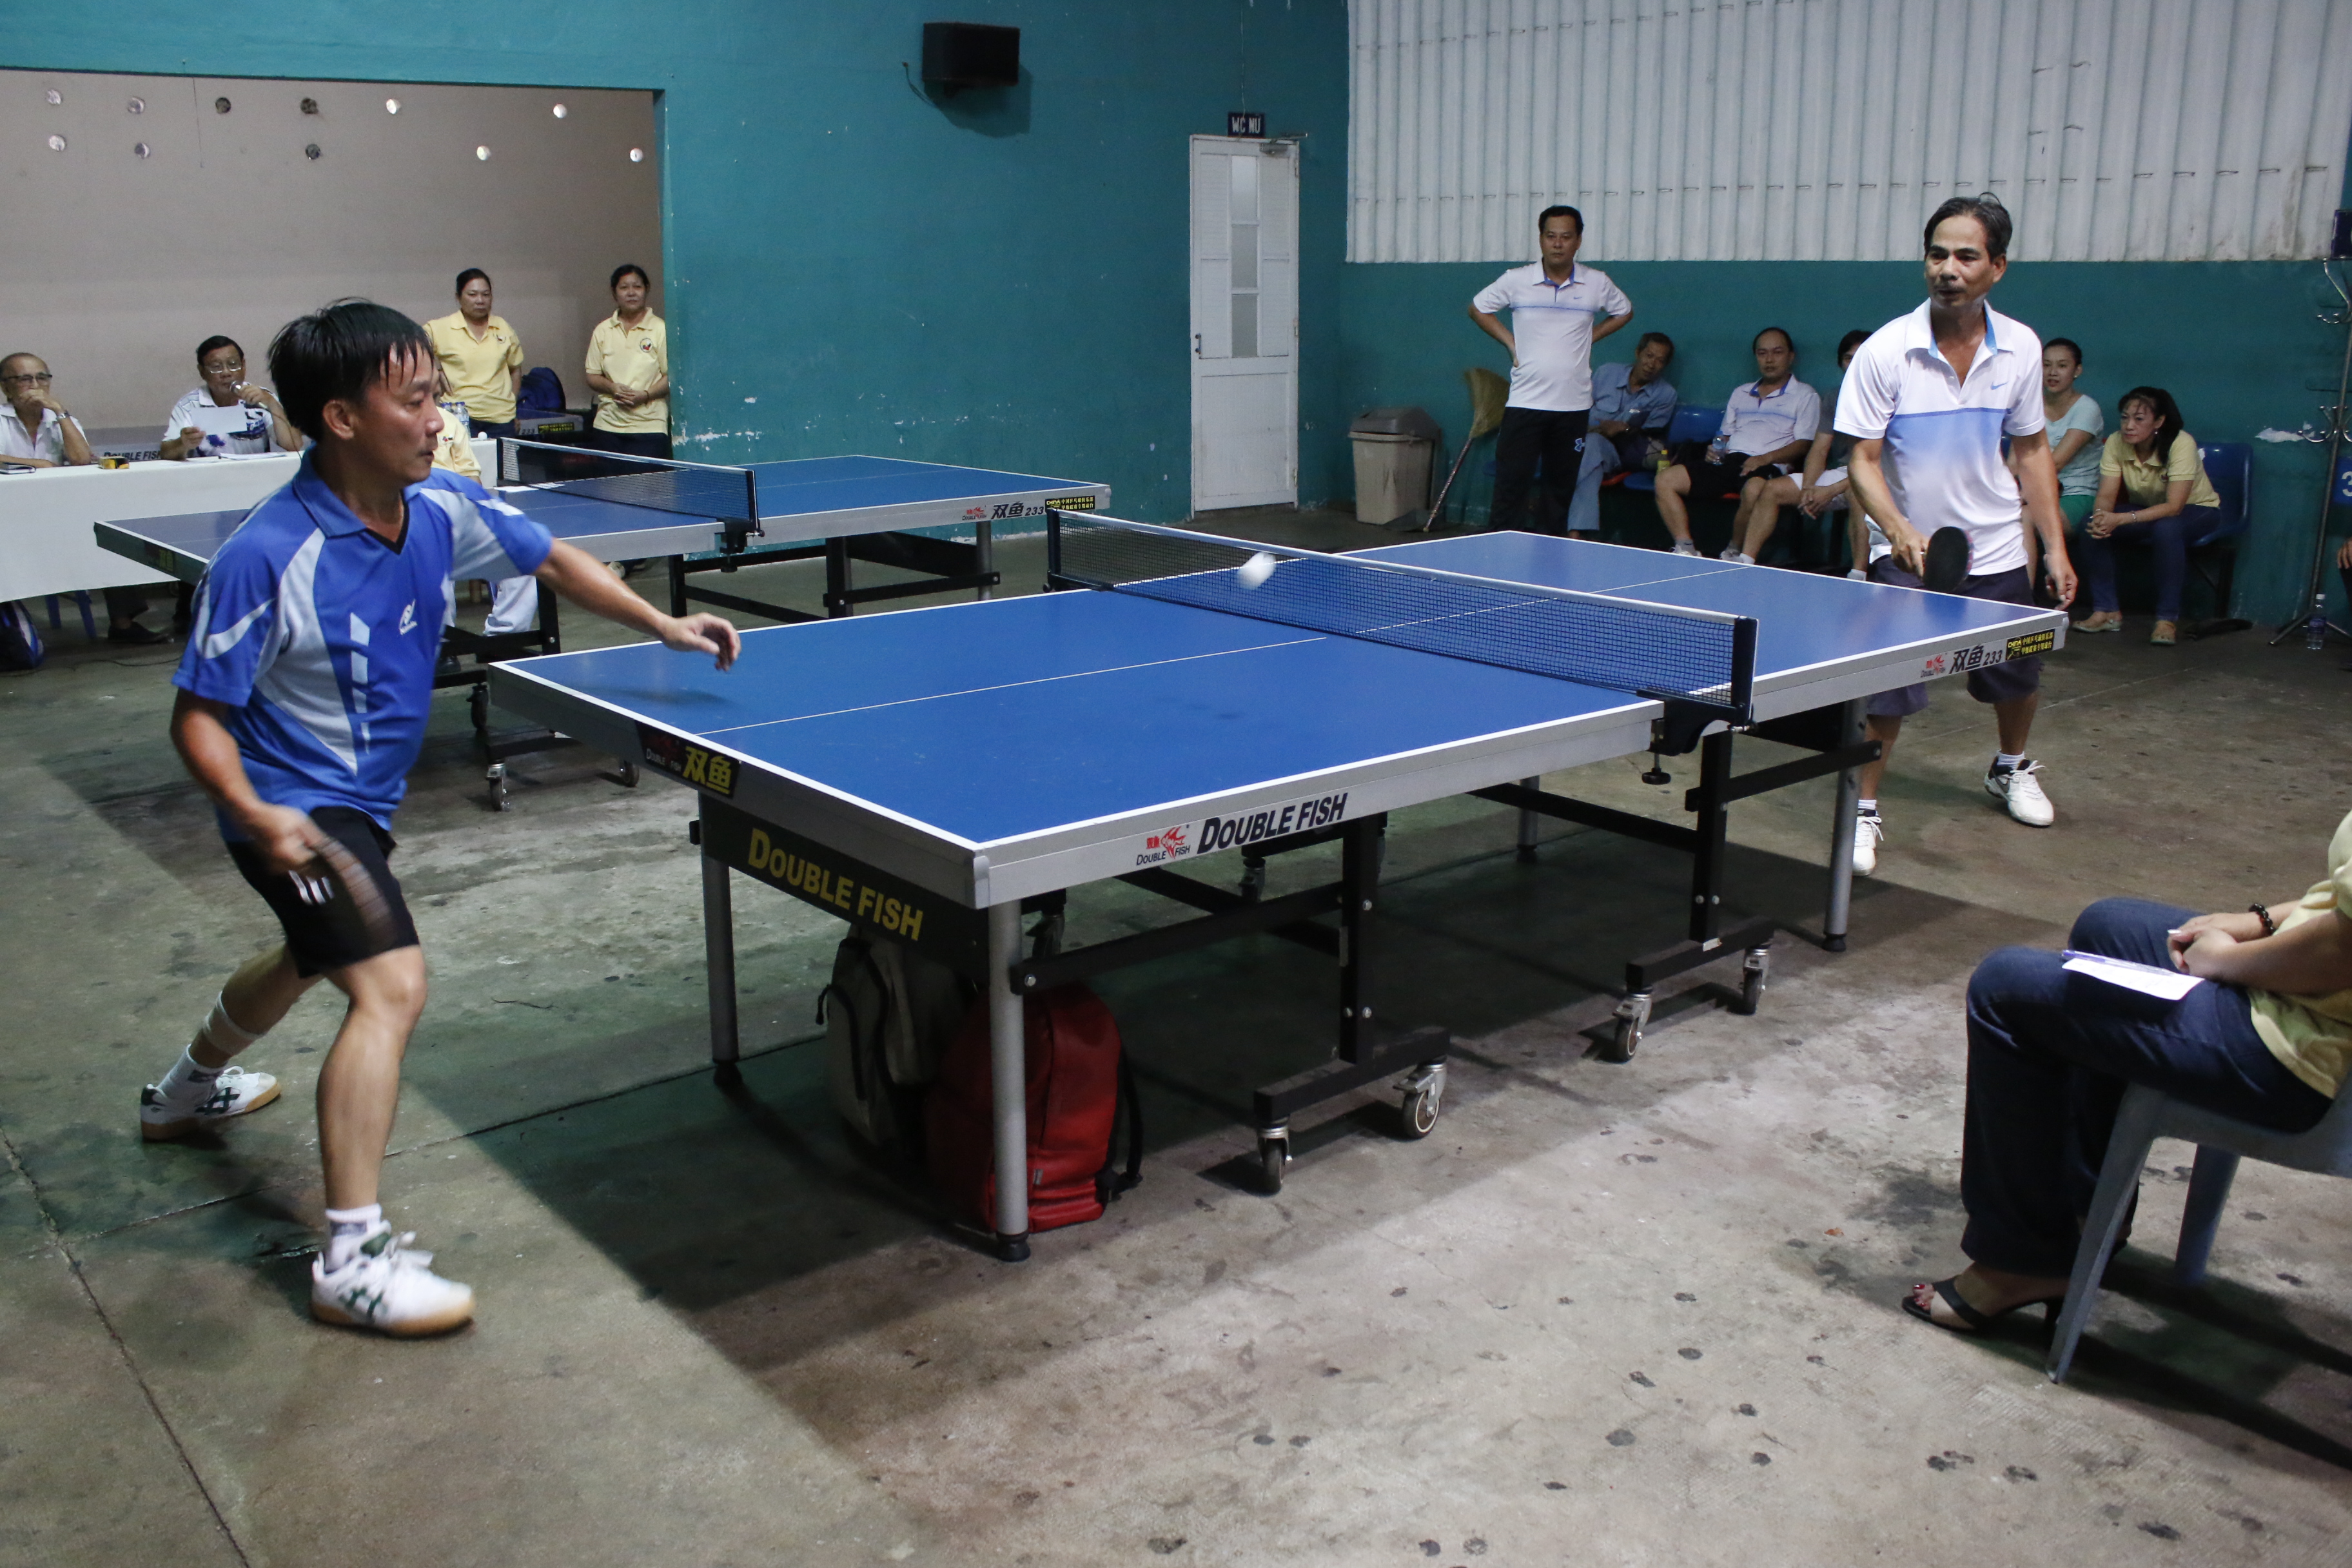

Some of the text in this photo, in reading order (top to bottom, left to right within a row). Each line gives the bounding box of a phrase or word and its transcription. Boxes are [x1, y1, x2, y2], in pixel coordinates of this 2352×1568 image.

[1232, 117, 1246, 133] WC
[991, 502, 1044, 520] 双鱼 233
[1949, 645, 2003, 674] 双鱼 233
[682, 745, 733, 795] 双鱼
[1197, 792, 1348, 854] DOUBLE FISH
[1136, 845, 1191, 866] DOUBLE FISH
[748, 828, 923, 941] DOUBLE FISH
